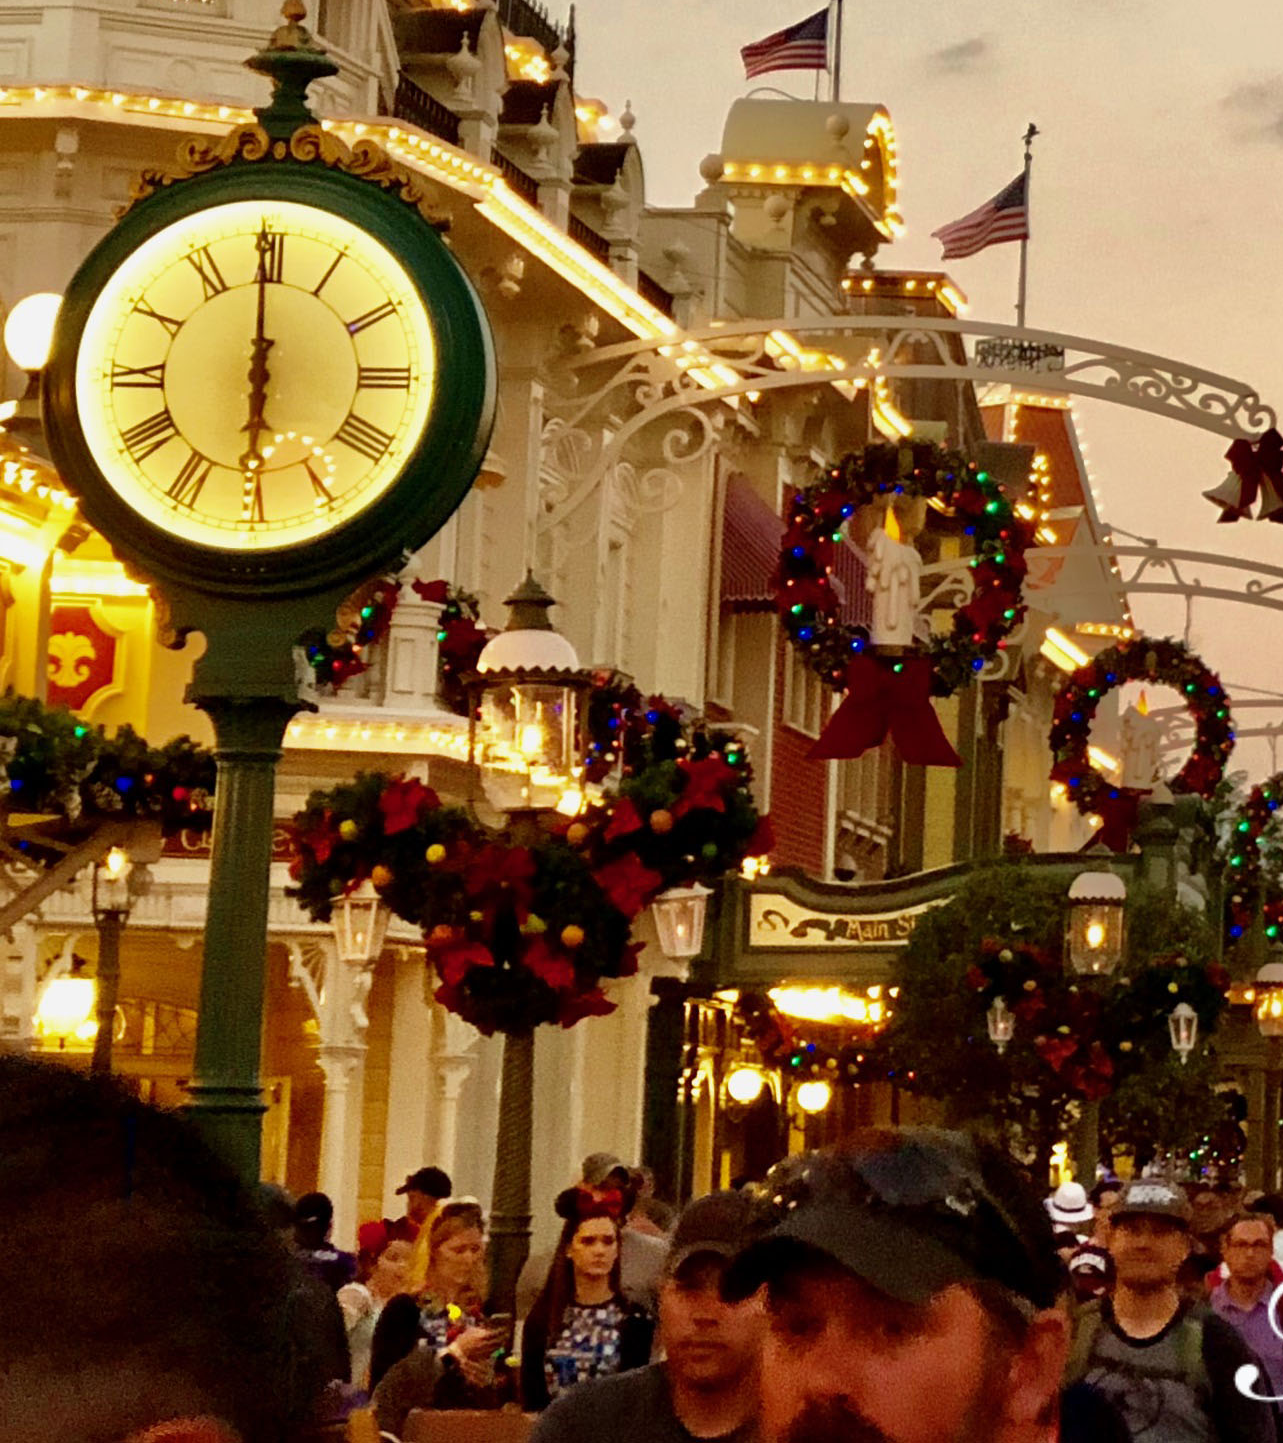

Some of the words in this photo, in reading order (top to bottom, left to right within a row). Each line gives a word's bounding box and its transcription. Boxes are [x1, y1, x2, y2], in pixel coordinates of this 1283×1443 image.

[345, 299, 398, 336] II
[357, 366, 412, 390] III
[118, 406, 181, 466] VIII
[163, 448, 217, 512] VII
[846, 918, 890, 943] Main
